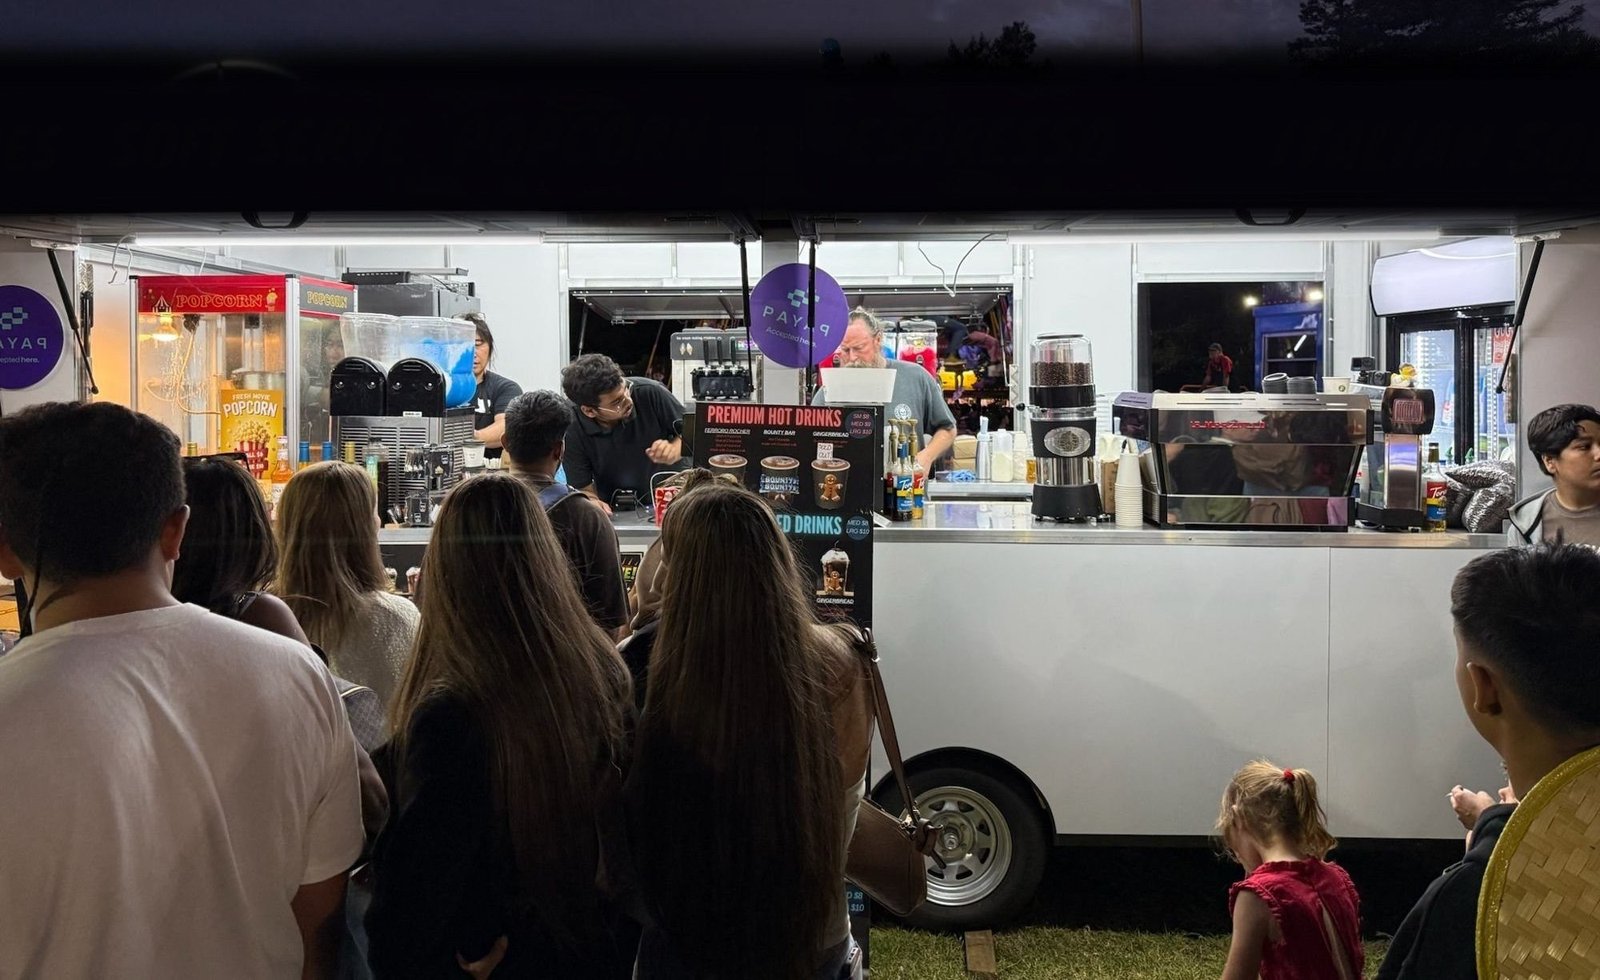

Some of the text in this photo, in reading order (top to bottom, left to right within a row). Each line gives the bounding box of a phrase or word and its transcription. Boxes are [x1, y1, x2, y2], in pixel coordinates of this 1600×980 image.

[175, 294, 264, 308] POPCORN
[306, 290, 348, 309] POPCORN
[765, 326, 800, 343] Accepted
[0, 356, 20, 364] epted
[232, 392, 271, 401] FRESH MOVIE
[222, 400, 278, 418] POPCORN
[707, 405, 842, 428] PREMIUM HOT DRINKS
[812, 430, 850, 438] GINGERBREAD
[765, 476, 794, 484] BOUNTY
[764, 483, 793, 491] BOUNTY
[775, 514, 842, 535] ED DRINKS
[816, 597, 855, 605] GINGERBREAD
